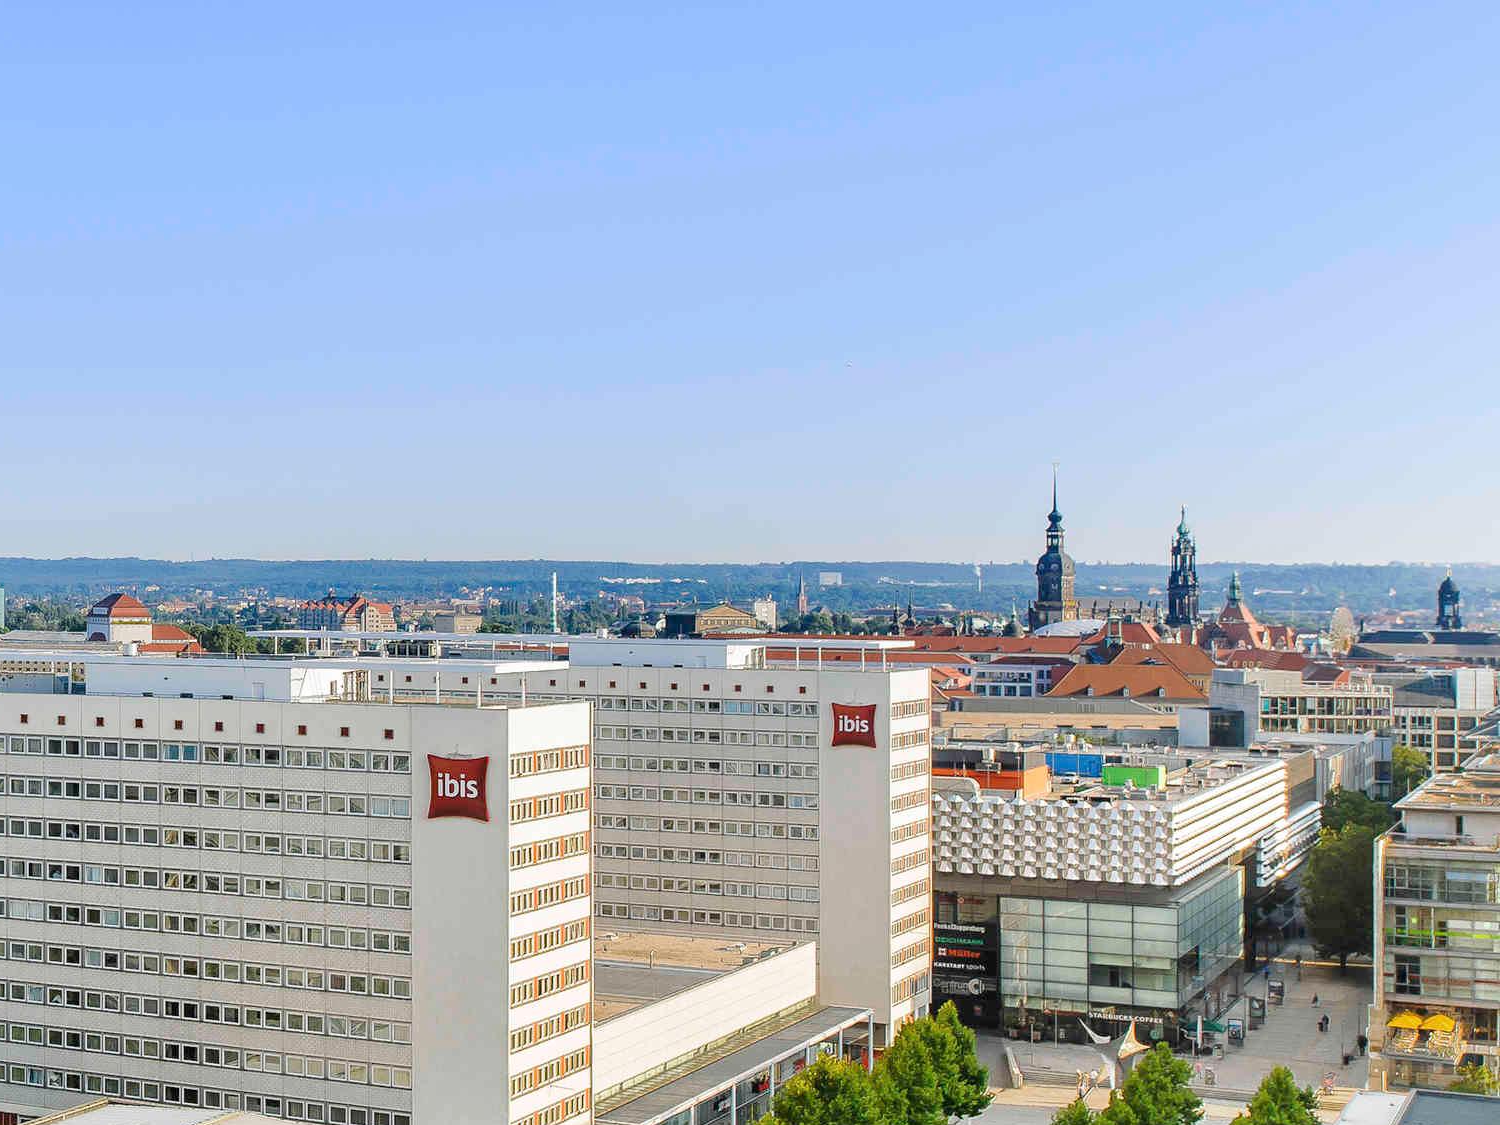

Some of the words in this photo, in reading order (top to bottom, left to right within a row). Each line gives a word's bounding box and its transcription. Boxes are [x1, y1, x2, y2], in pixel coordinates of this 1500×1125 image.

[839, 715, 869, 733] ibis
[438, 772, 478, 798] ibis
[1089, 1011, 1133, 1022] STARBUCKS
[1135, 1015, 1164, 1025] COFFEE
